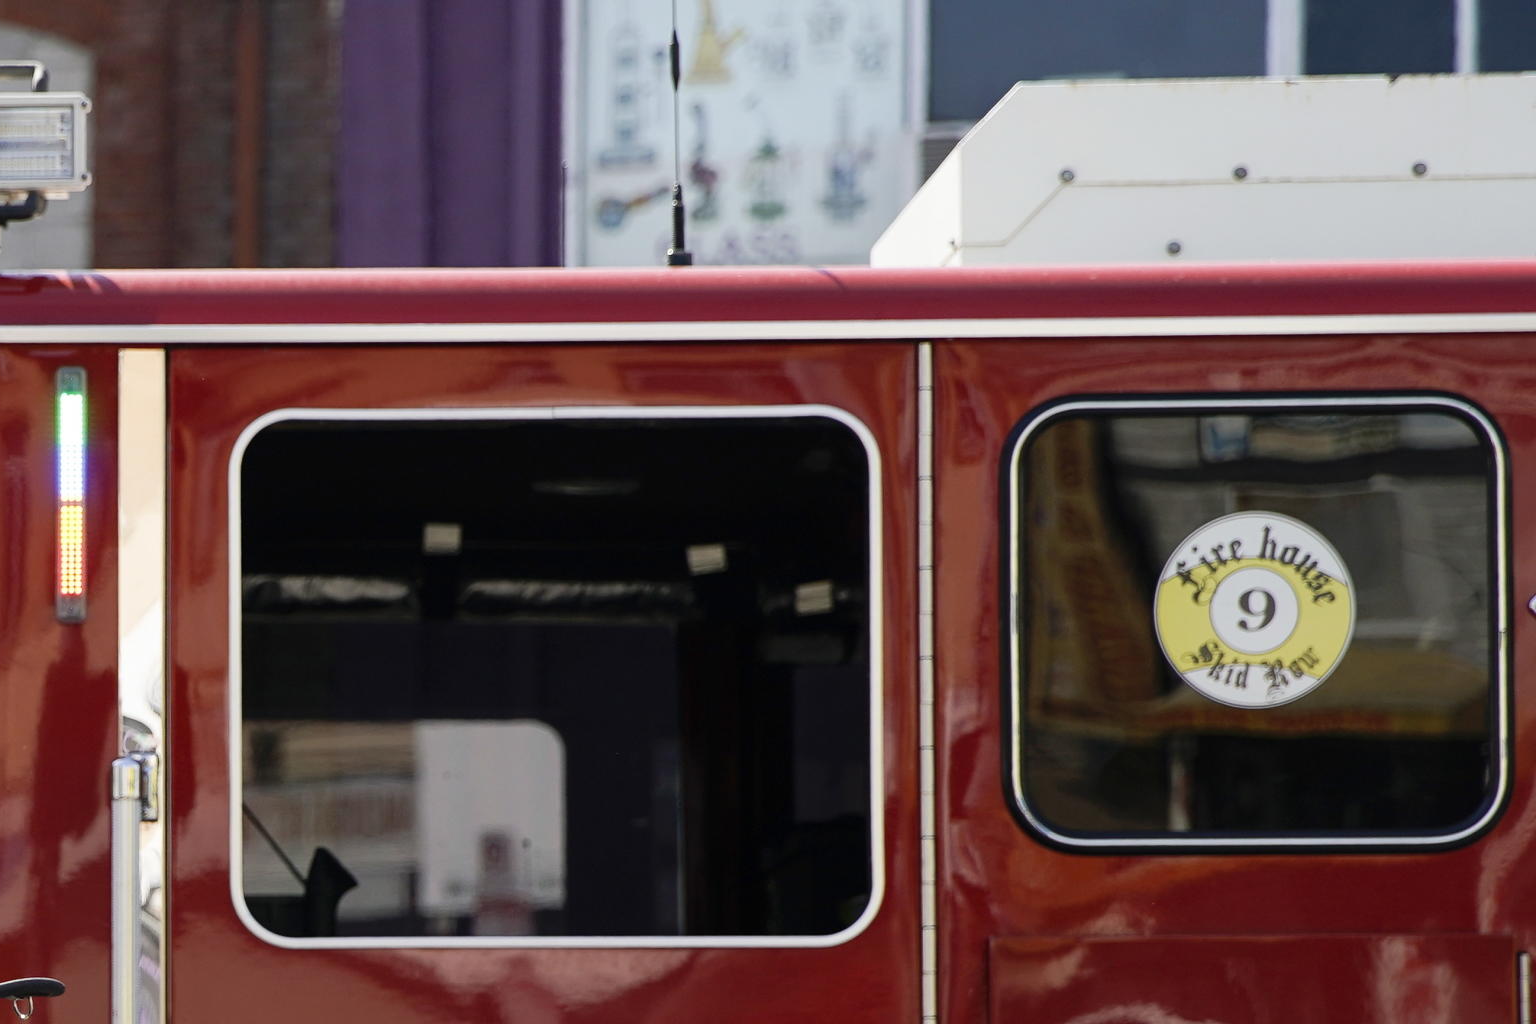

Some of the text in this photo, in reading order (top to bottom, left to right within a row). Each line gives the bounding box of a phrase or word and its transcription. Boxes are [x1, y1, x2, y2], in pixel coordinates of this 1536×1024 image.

[1257, 523, 1336, 607] house
[1237, 587, 1277, 633] 9
[1181, 638, 1321, 700] Skid Row
